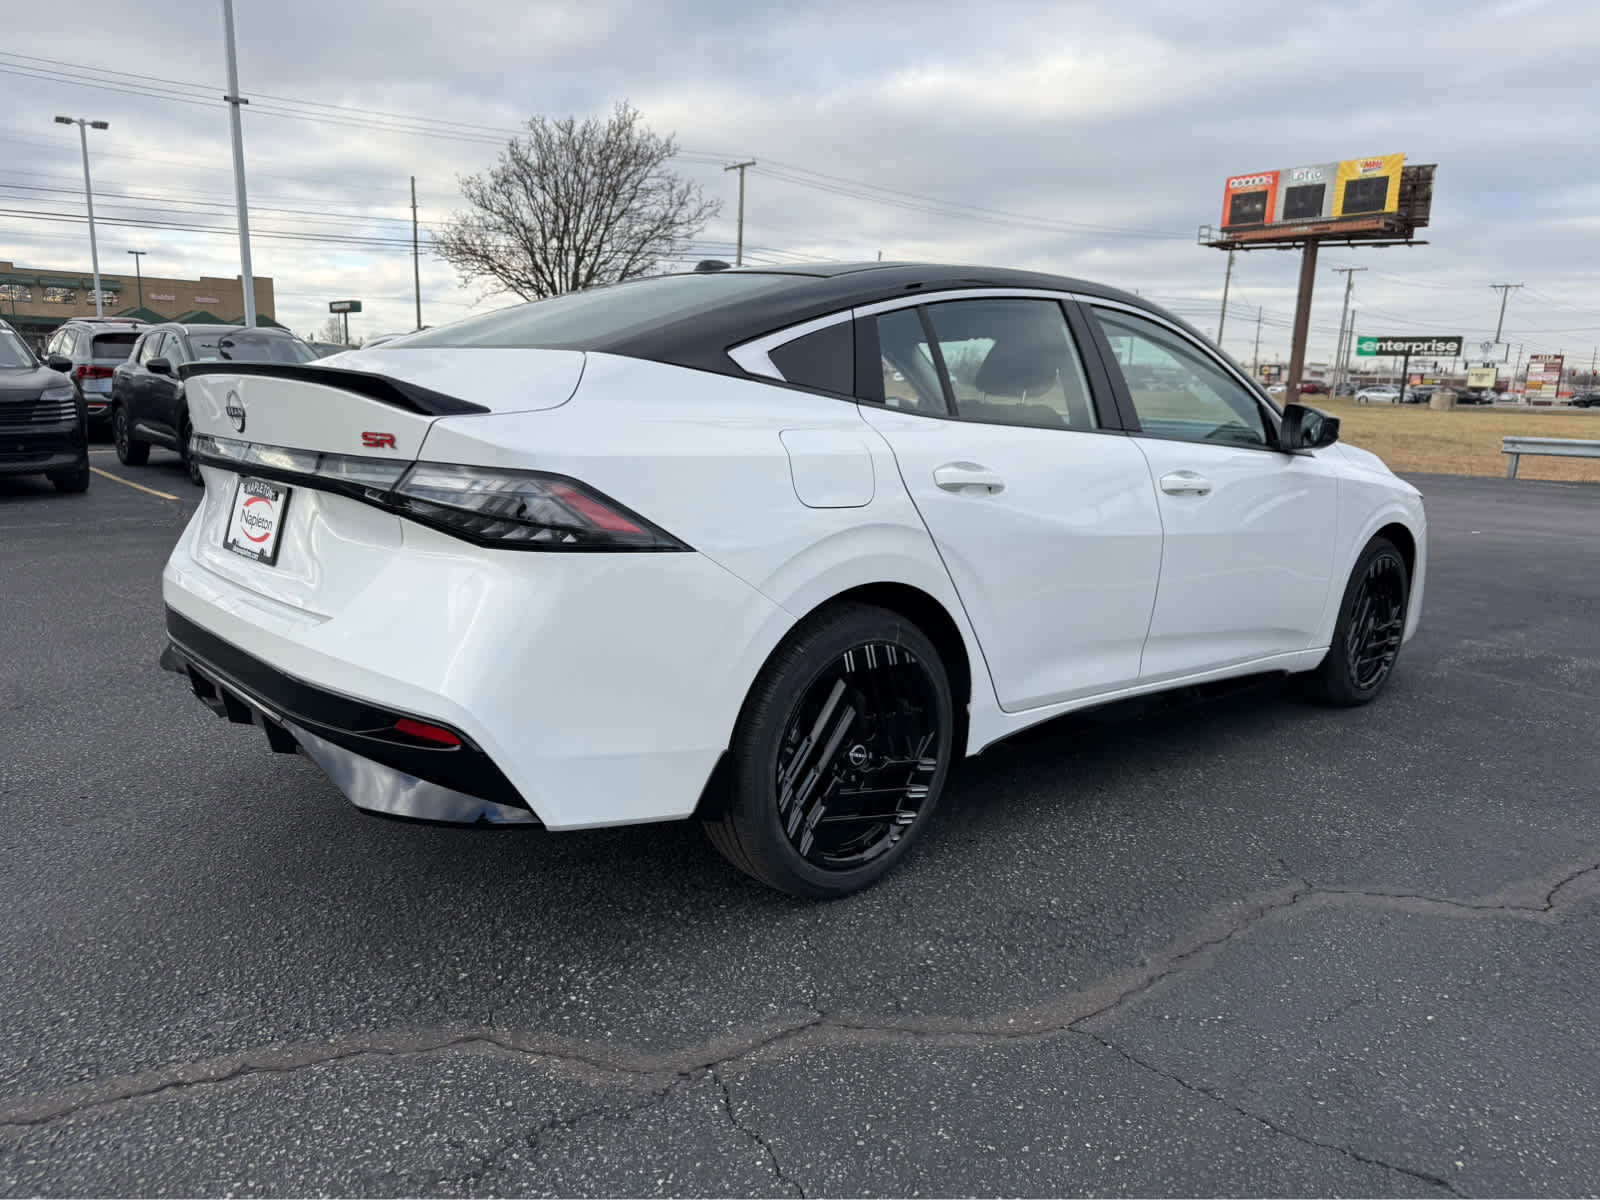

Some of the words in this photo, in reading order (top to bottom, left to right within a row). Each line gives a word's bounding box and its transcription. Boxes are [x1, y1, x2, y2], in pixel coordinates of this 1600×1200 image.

[1360, 339, 1458, 353] enterprise
[361, 432, 397, 449] SR
[241, 509, 272, 531] Napleton
